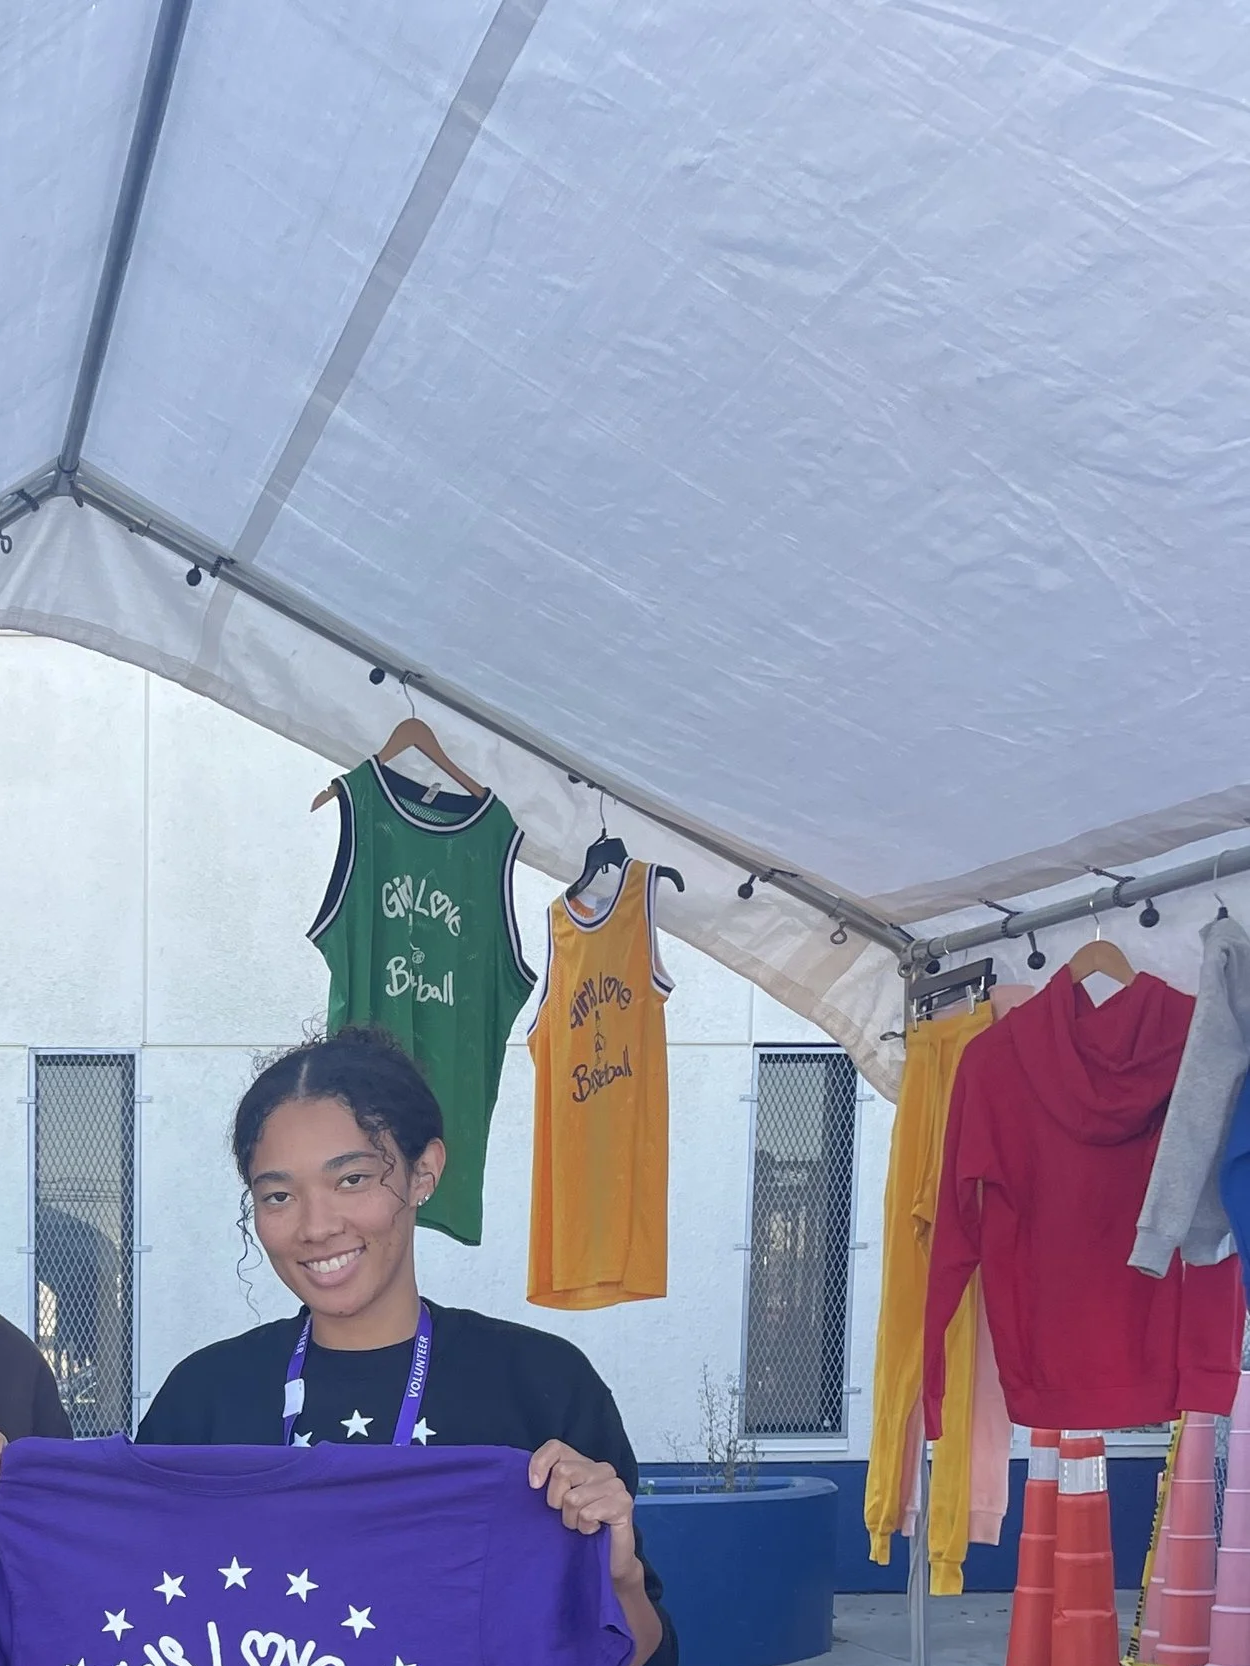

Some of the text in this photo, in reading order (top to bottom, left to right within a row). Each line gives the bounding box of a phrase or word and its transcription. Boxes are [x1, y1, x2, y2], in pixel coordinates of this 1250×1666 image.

[414, 878, 461, 937] Love
[599, 971, 632, 1010] Love
[408, 1335, 428, 1398] VOLUNTEER
